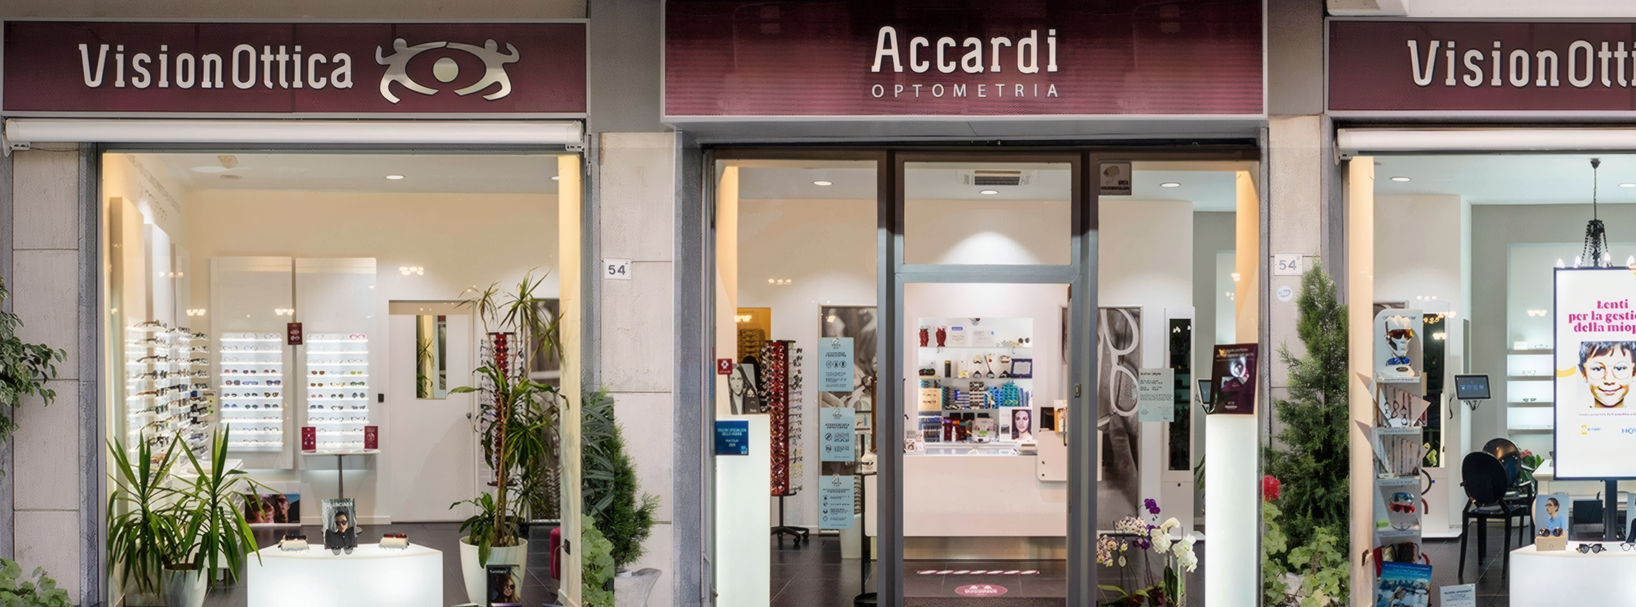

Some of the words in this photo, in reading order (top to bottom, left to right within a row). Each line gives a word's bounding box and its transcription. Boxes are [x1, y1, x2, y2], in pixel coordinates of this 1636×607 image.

[871, 25, 1058, 74] Accardi
[78, 43, 354, 90] VisionOttica
[871, 84, 1059, 98] OPTOMETRIA
[608, 264, 626, 276] 54
[1279, 259, 1297, 271] 54
[1596, 298, 1629, 309] Lenti
[1568, 313, 1589, 324] per
[1591, 310, 1603, 321] la
[1605, 310, 1636, 324] gesti
[1573, 322, 1605, 333] della
